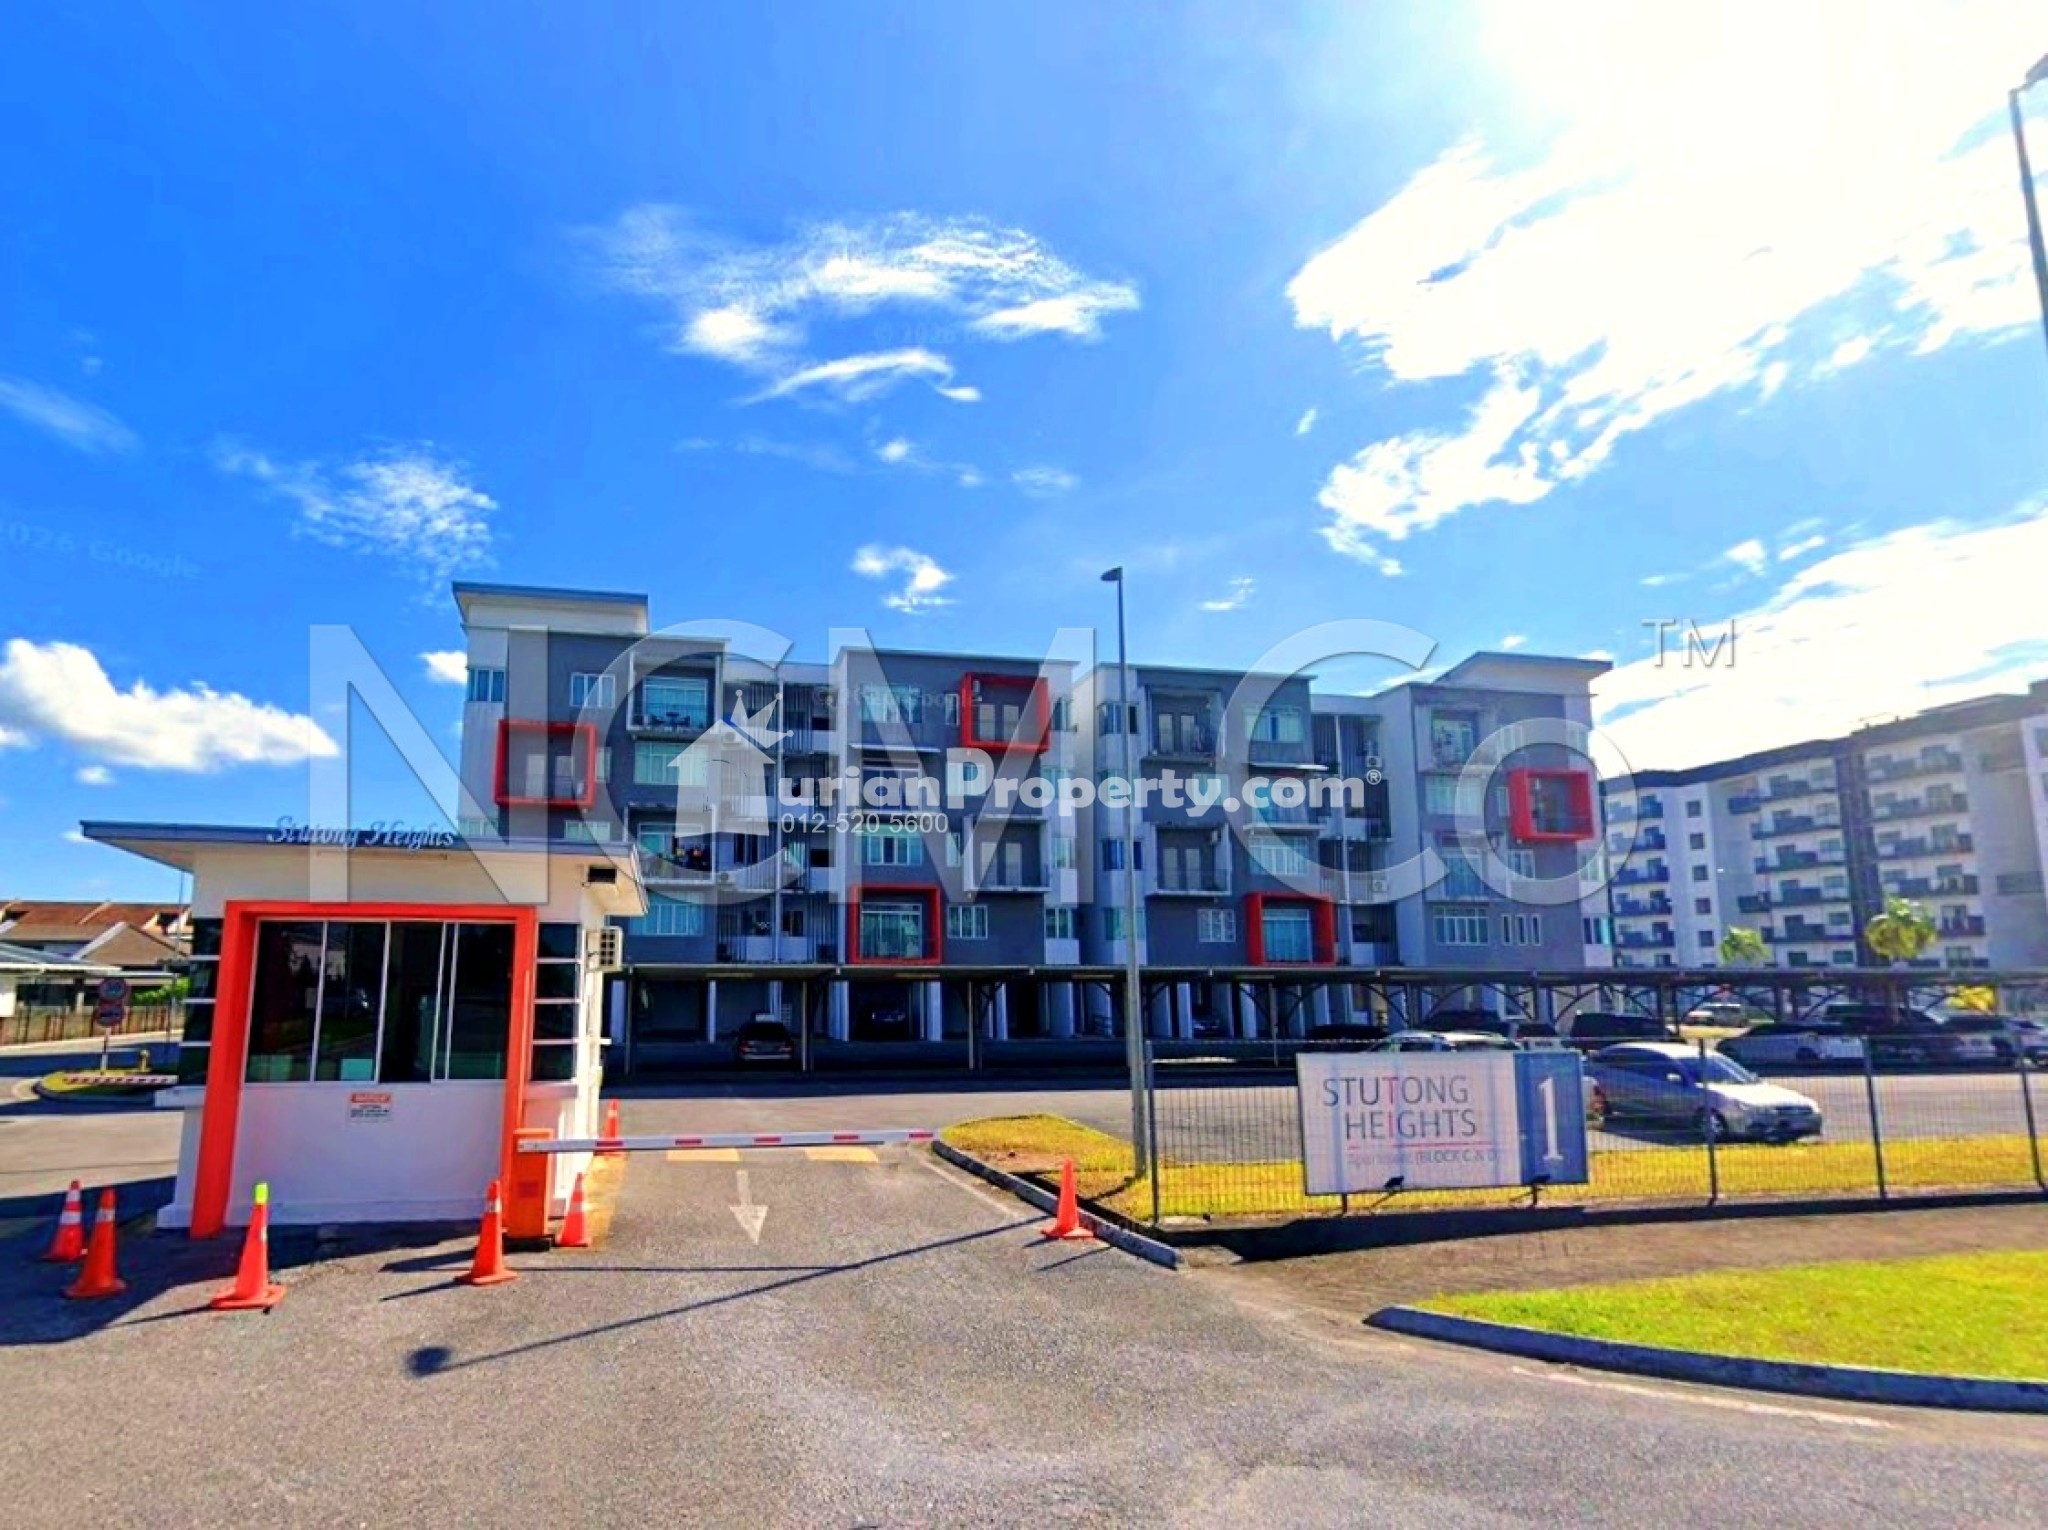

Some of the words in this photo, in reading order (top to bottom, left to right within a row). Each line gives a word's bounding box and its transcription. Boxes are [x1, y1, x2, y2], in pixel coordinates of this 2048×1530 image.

[364, 820, 454, 850] Heights
[1322, 1075, 1469, 1107] STUTONG
[1345, 1108, 1477, 1141] HEIGHTS
[1538, 1076, 1566, 1161] 1
